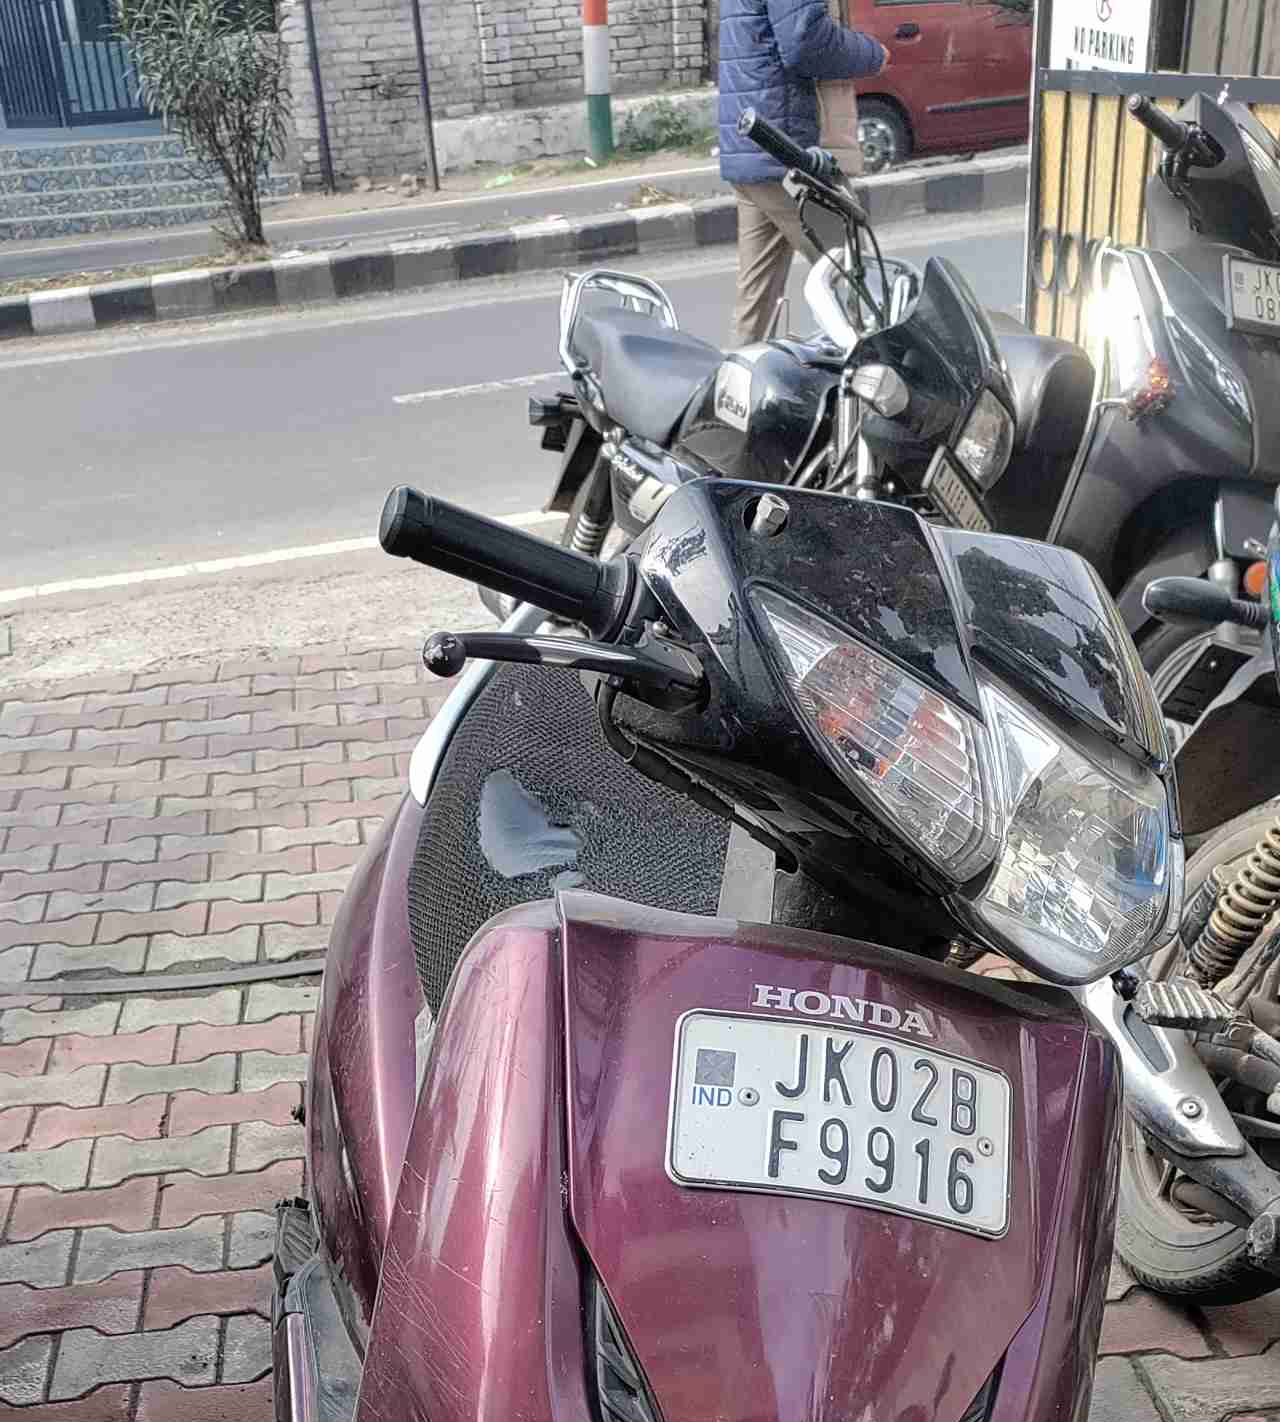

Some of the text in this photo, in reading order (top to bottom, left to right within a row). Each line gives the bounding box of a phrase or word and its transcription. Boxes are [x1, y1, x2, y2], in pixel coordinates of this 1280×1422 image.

[1087, 28, 1134, 64] PARKING
[752, 984, 934, 1037] HONDA
[691, 1086, 733, 1108] IND
[775, 1034, 977, 1136] JK02B
[767, 1109, 975, 1215] F9916
